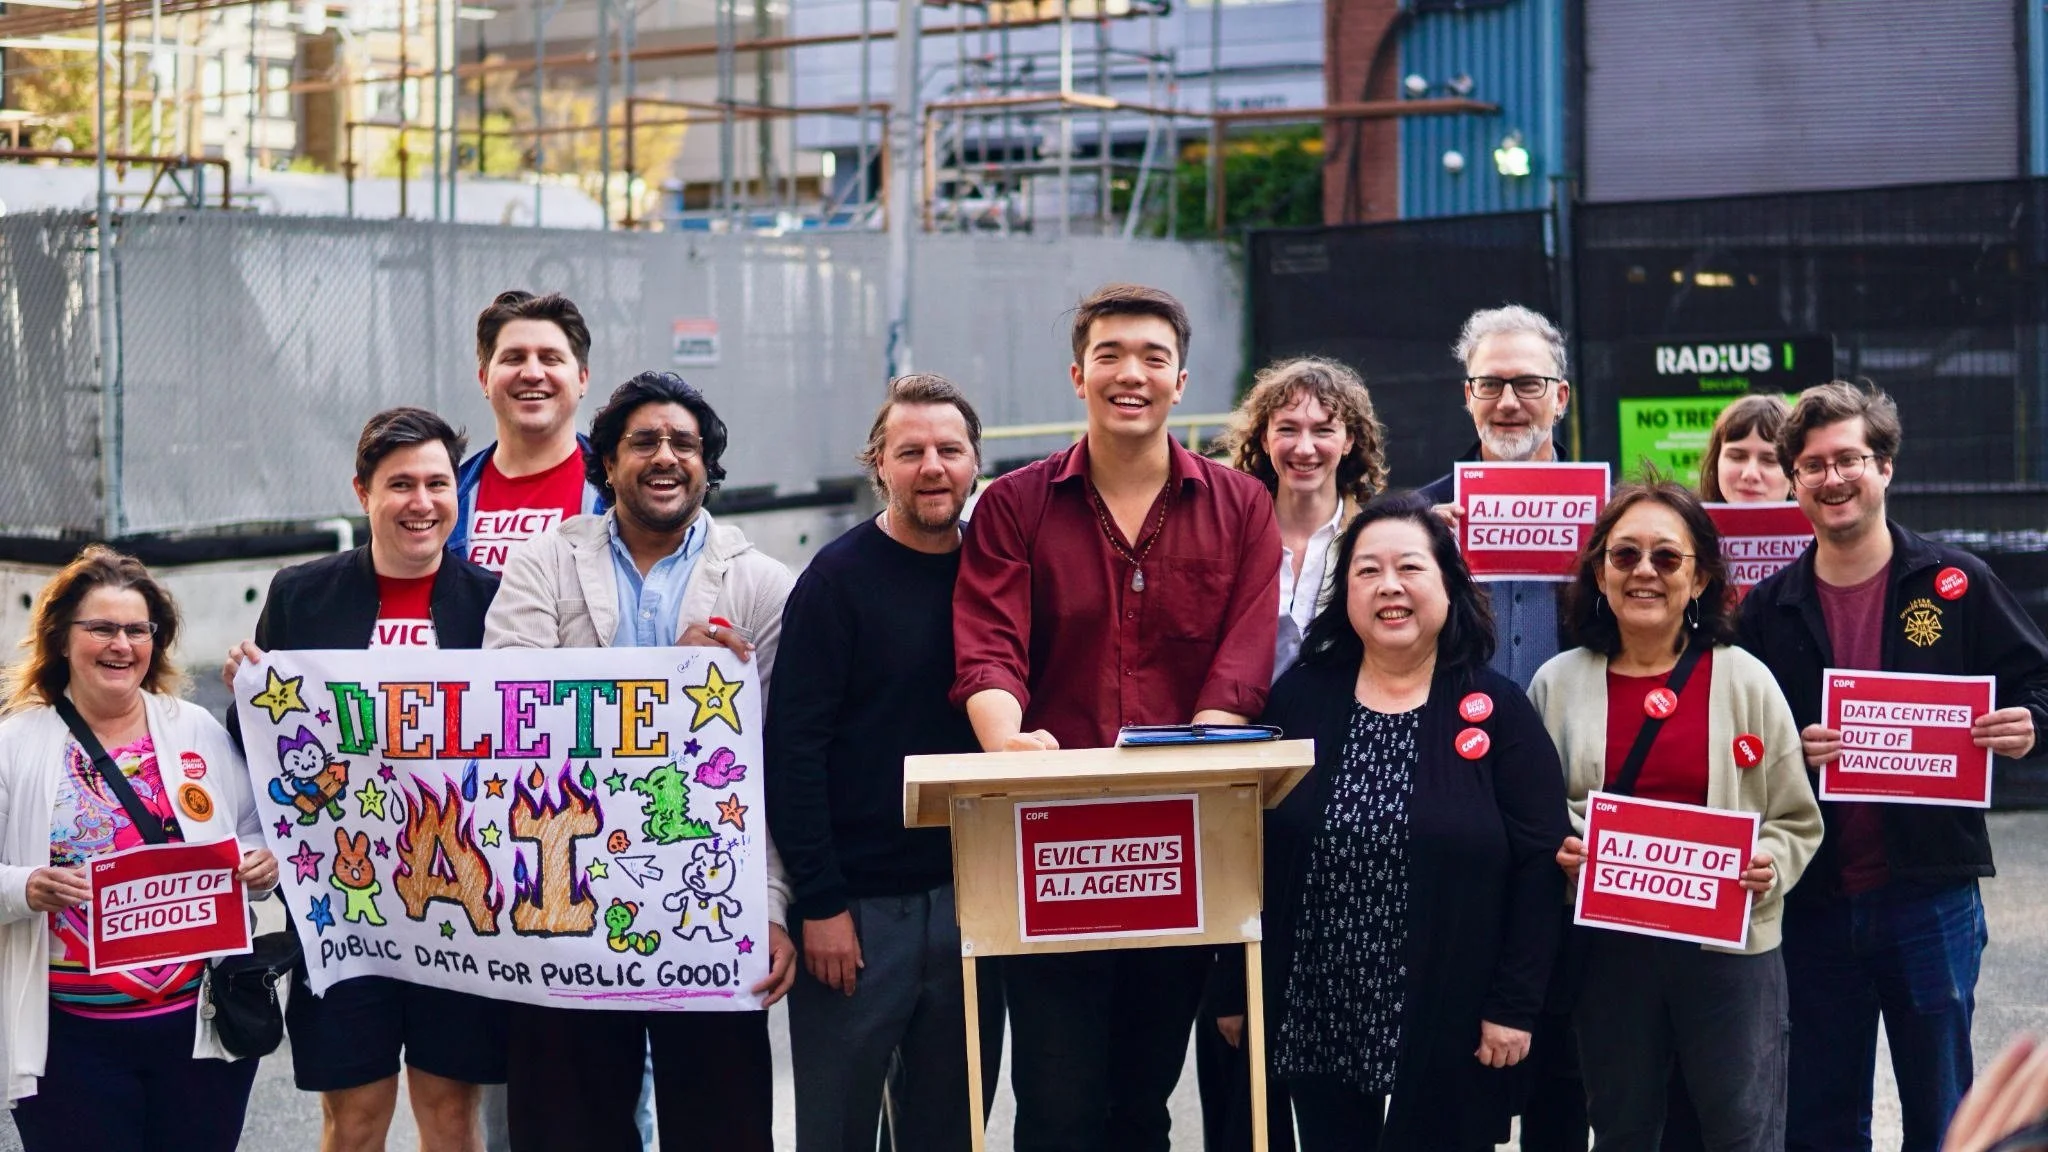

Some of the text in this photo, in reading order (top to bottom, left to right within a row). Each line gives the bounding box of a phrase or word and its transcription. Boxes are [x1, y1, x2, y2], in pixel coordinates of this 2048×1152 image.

[1656, 343, 1772, 374] RADIUS
[1637, 410, 1668, 428] NO
[1464, 471, 1484, 479] COPE
[1472, 501, 1592, 518] A.I. OUT OF
[474, 514, 556, 534] EVICT
[1472, 528, 1574, 545] SCHOOLS
[468, 545, 509, 566] EN
[1718, 541, 1752, 556] ICT
[369, 624, 438, 645] VIC
[1833, 679, 1856, 689] COPE
[325, 679, 669, 760] DELETE
[1843, 704, 1968, 723] DATA CENTRES
[1842, 730, 1908, 747] OUT OF
[1738, 740, 1757, 762] COPE
[1841, 754, 1952, 773] VANCOUVER
[1026, 812, 1049, 820] COPE
[1596, 802, 1618, 813] COPE
[1038, 841, 1179, 867] EVICT KEN'S
[1601, 838, 1736, 871] A.I. OUT OF
[95, 862, 116, 873] COPE
[104, 873, 228, 909] A.I. OUT OF
[1040, 871, 1177, 897] A.I. AGENTS
[1598, 868, 1714, 901] SCHOOLS
[106, 902, 211, 936] SCHOOLS
[321, 934, 740, 987] PUBLIC DATA FOR PUBLIC GOOD!
